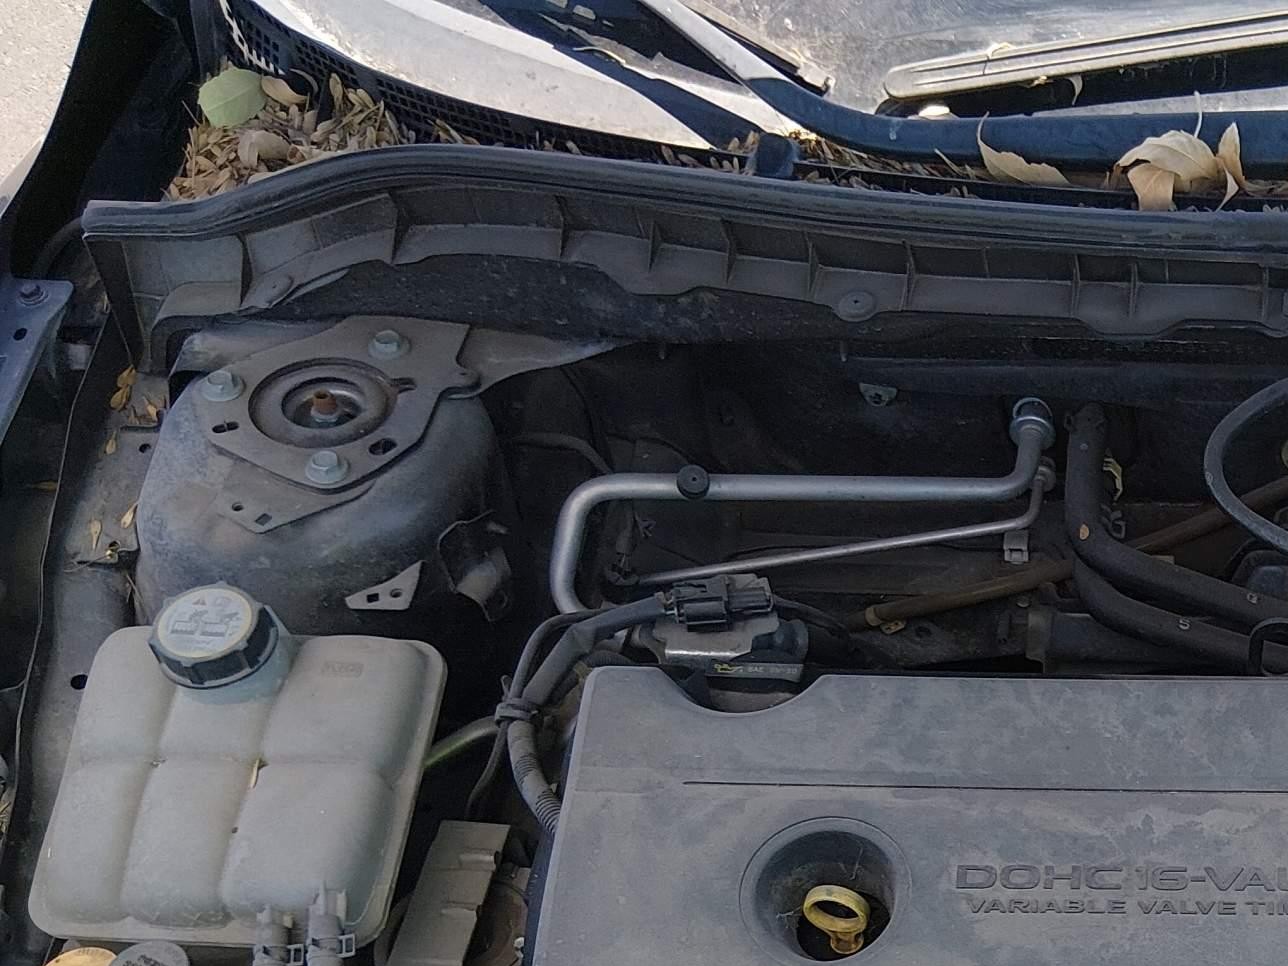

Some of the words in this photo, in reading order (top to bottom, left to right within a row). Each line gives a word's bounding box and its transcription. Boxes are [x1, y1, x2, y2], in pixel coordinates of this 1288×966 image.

[956, 864, 1122, 890] DOHC
[969, 899, 1127, 914] VARIABLE
[1137, 900, 1238, 915] VALVE
